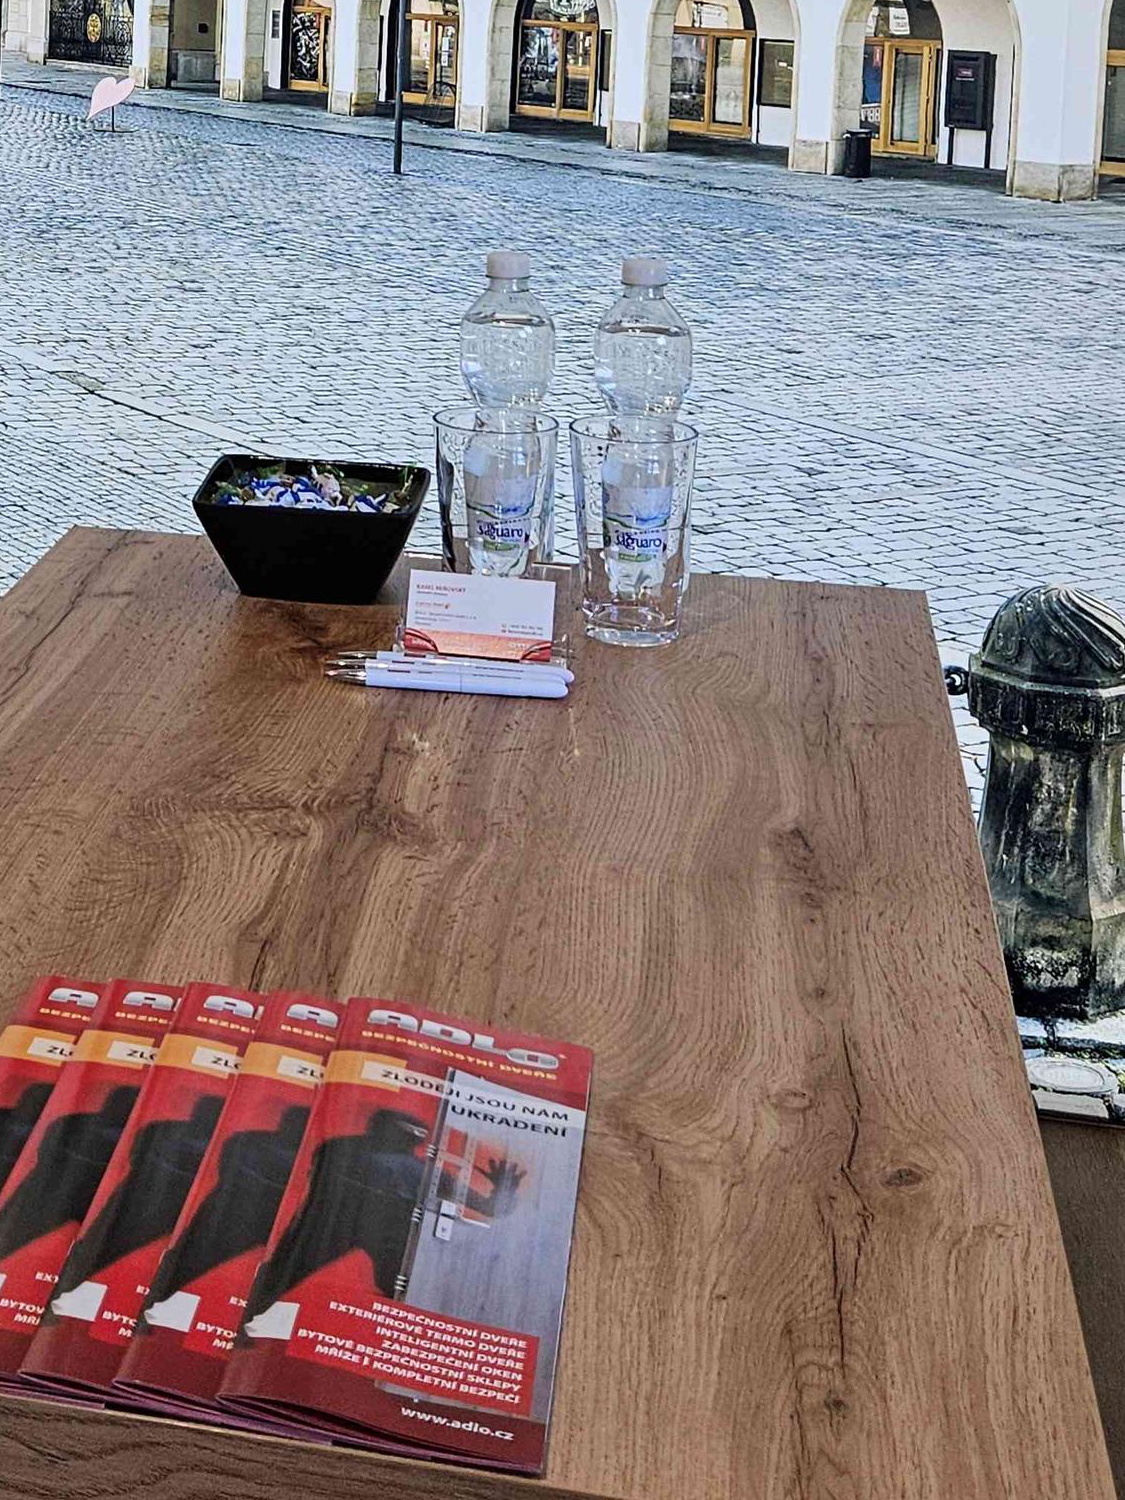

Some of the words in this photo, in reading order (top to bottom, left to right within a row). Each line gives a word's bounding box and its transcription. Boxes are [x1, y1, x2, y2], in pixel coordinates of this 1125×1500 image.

[122, 991, 182, 1012] A
[203, 995, 265, 1020] A
[115, 1011, 172, 1025] BEZPE
[367, 1009, 559, 1070] ADLO
[47, 1046, 73, 1057] ZL
[297, 1064, 324, 1079] ZL
[465, 1093, 516, 1112] JSOU
[451, 1104, 567, 1138] UKRADENÍ
[373, 1302, 478, 1338] BEZPEČNOSTNÍ
[195, 1322, 237, 1339] BYTO
[425, 1328, 475, 1348] TERMO
[467, 1374, 521, 1392] SKLEPY
[481, 1366, 523, 1381] OKEN
[401, 1407, 515, 1441] www.adlo.cz
